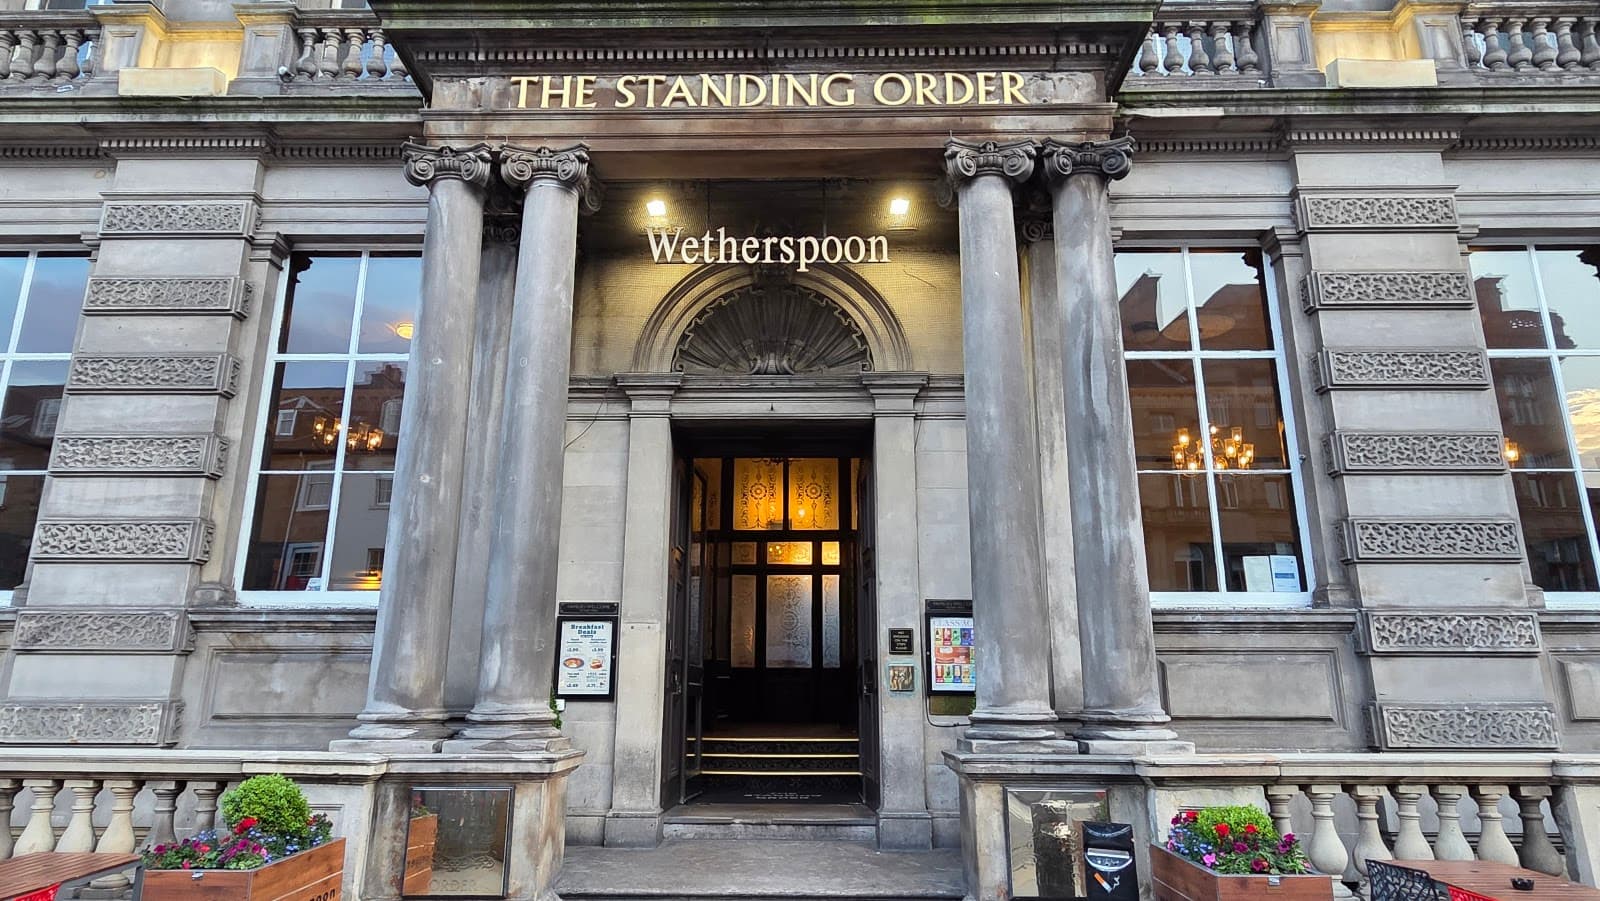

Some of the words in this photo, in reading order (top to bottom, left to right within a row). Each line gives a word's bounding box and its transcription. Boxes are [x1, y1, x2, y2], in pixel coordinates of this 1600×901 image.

[510, 75, 598, 108] THE
[614, 73, 856, 108] STANDING
[873, 72, 1030, 106] ORDER
[646, 226, 892, 272] Wetherspoon
